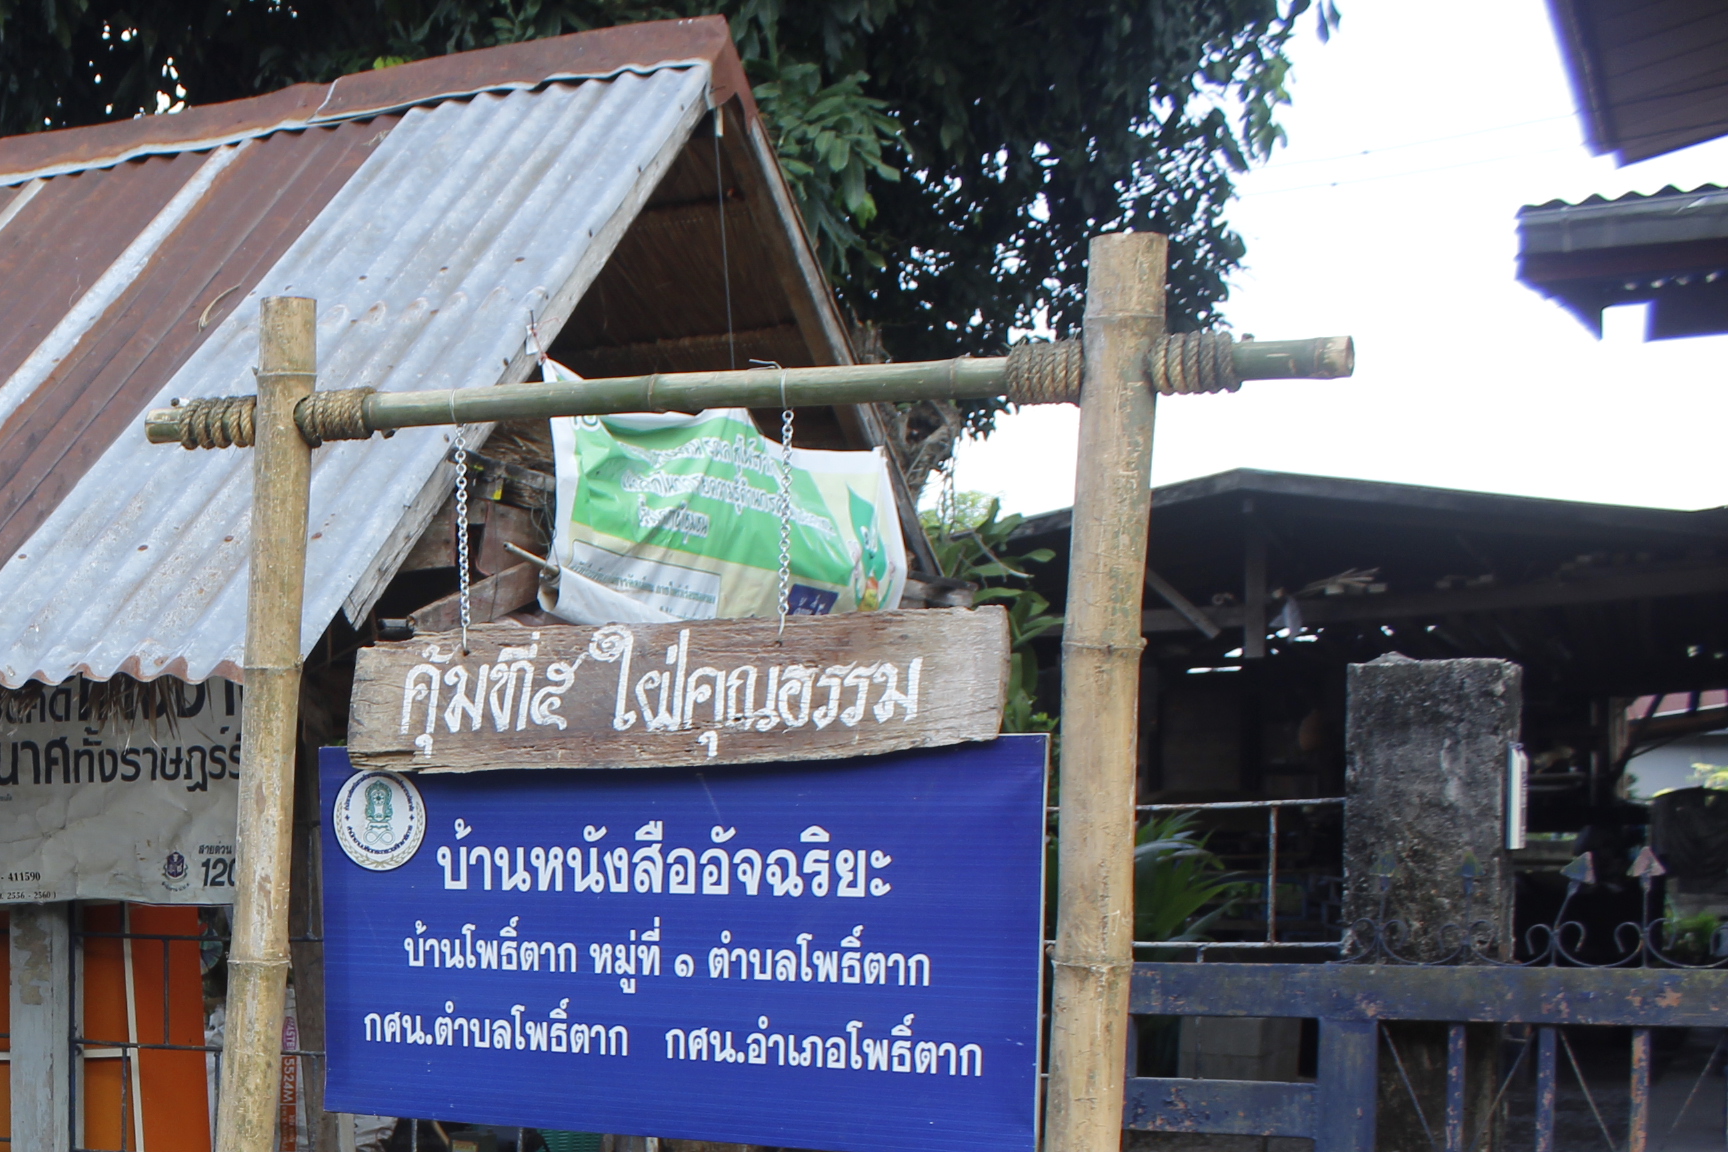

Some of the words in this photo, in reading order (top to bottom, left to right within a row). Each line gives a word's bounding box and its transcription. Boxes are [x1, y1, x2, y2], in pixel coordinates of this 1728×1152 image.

[588, 625, 923, 761] ใฝ่คุณธรรม
[8, 872, 41, 881] 411590
[436, 818, 892, 898] บ้านหนังสืออัจฉริยะ
[403, 916, 578, 973] บ้านโพธิ์ตาก
[589, 916, 662, 993] หมู่ที่
[673, 955, 695, 978] ๑
[708, 925, 931, 986] ตำบลโพธิ์ตาก
[363, 998, 629, 1057] กศน.ตำบลโพธิ์ตาก
[664, 1014, 984, 1078] กศน.อำเภอโพธิ์ตาก
